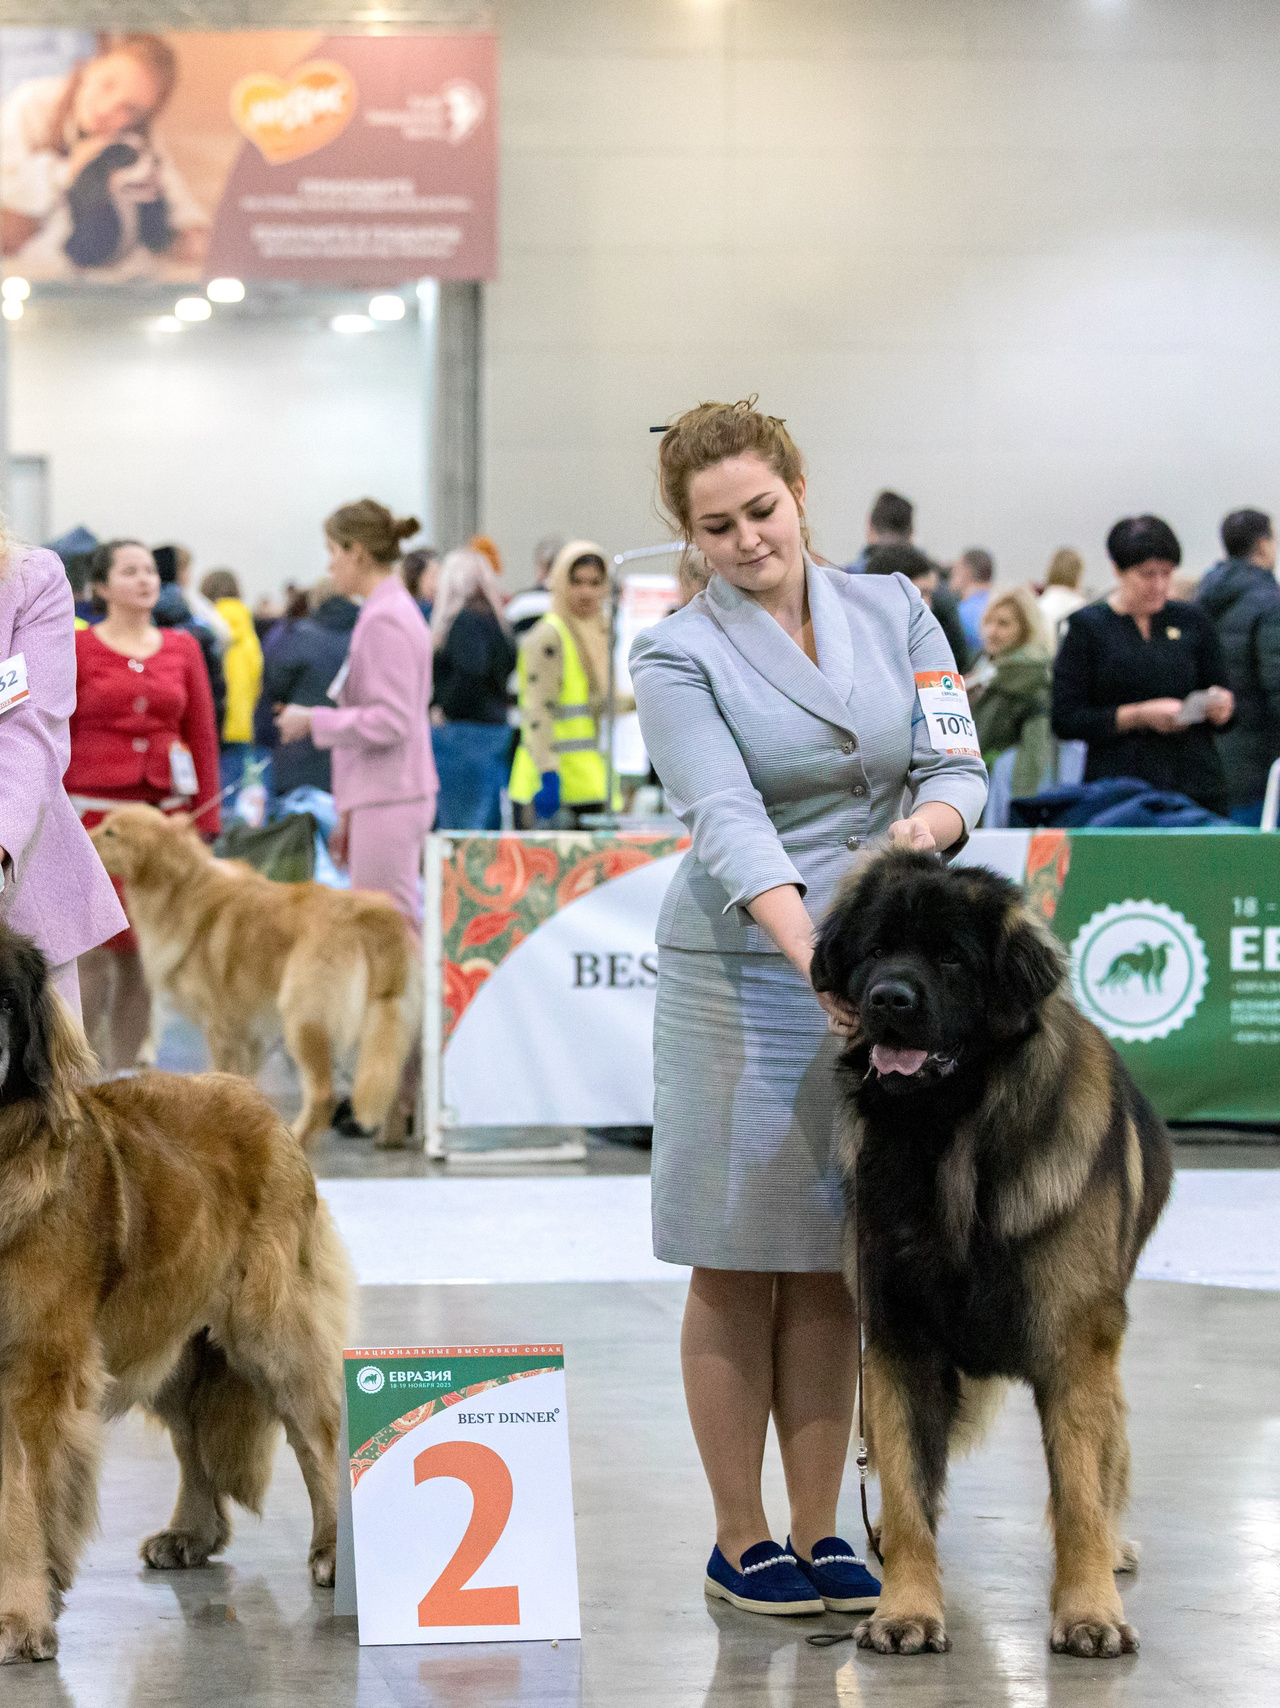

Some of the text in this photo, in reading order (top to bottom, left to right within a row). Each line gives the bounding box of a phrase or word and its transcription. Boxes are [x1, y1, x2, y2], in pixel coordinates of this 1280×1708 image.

[355, 1348, 450, 1356] НАЦИОНАЛЬНЫЕ
[389, 1370, 452, 1383] ЕВРАЗИЯ
[457, 1413, 495, 1424] BEST
[413, 1440, 521, 1628] 2
